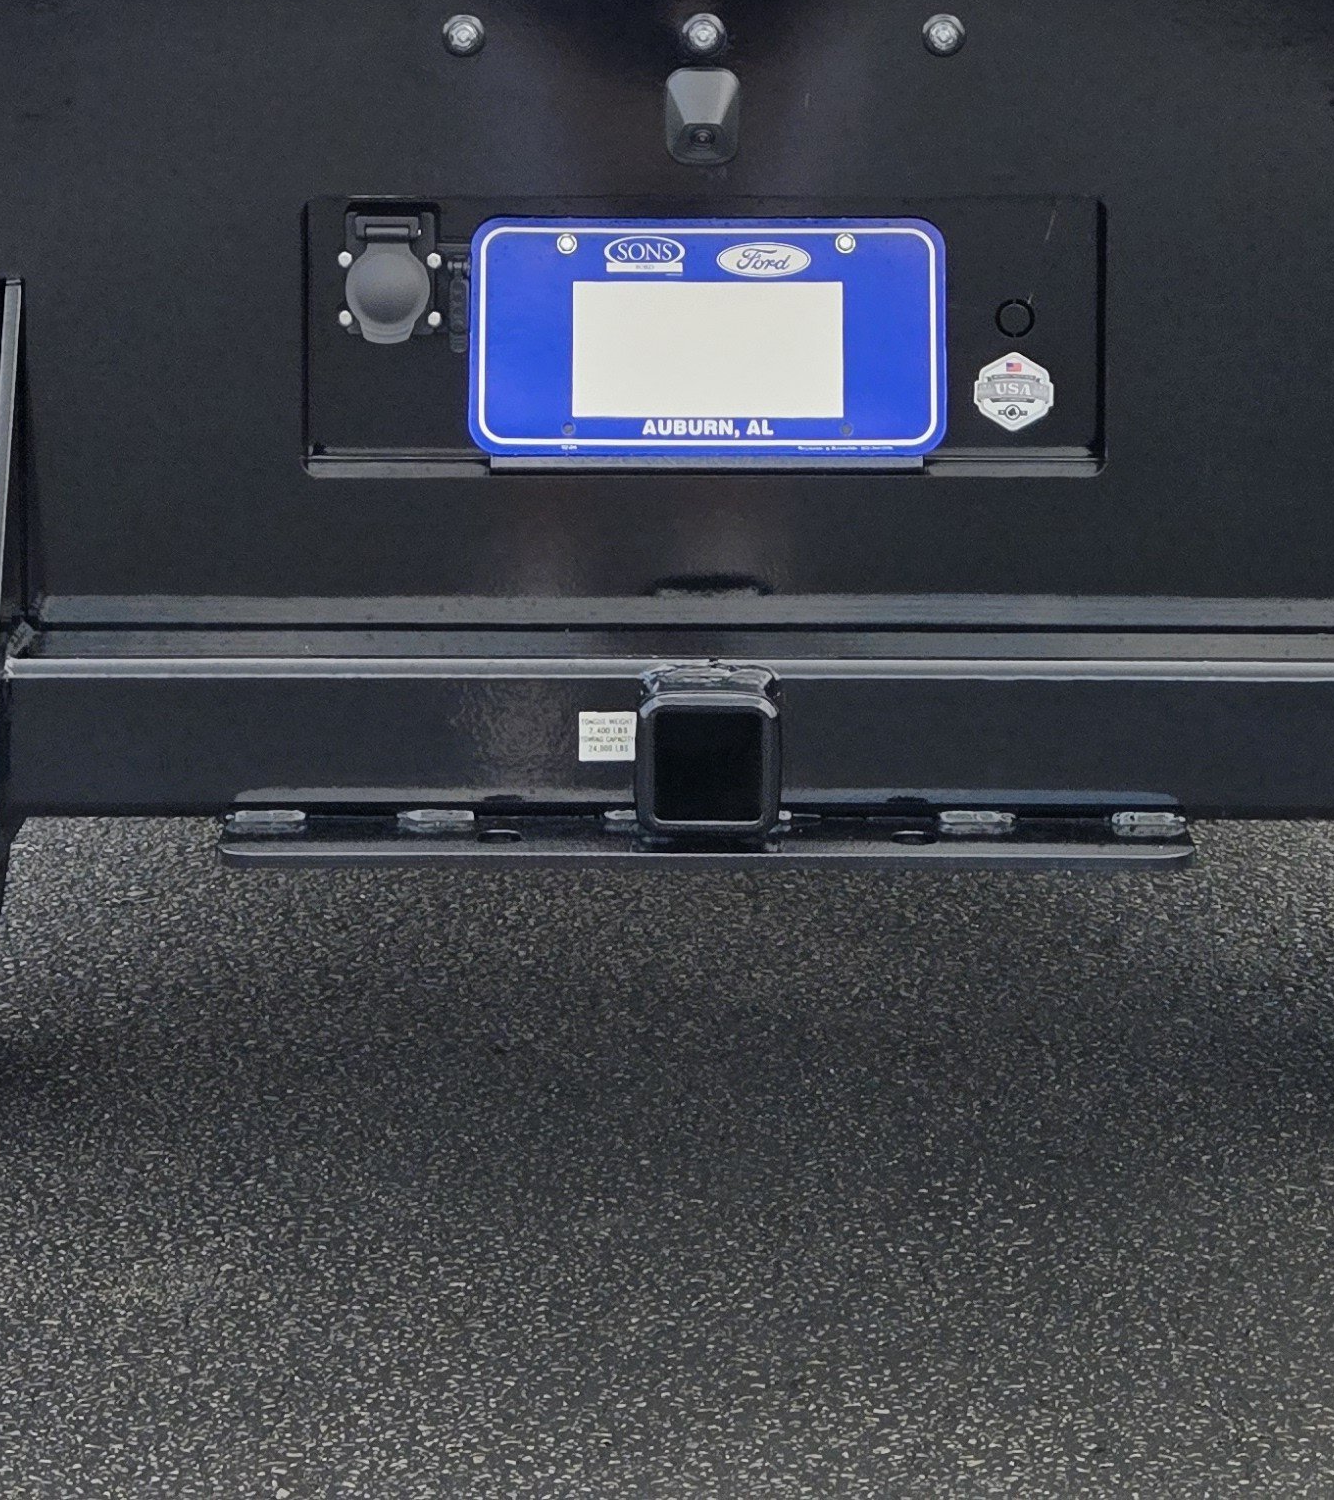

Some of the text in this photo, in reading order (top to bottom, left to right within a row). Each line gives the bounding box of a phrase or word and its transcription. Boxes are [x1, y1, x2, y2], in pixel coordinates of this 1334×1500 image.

[616, 242, 673, 261] SONS
[736, 247, 792, 270] Ford
[994, 382, 1032, 396] USA
[641, 418, 774, 438] AUBURN, AL
